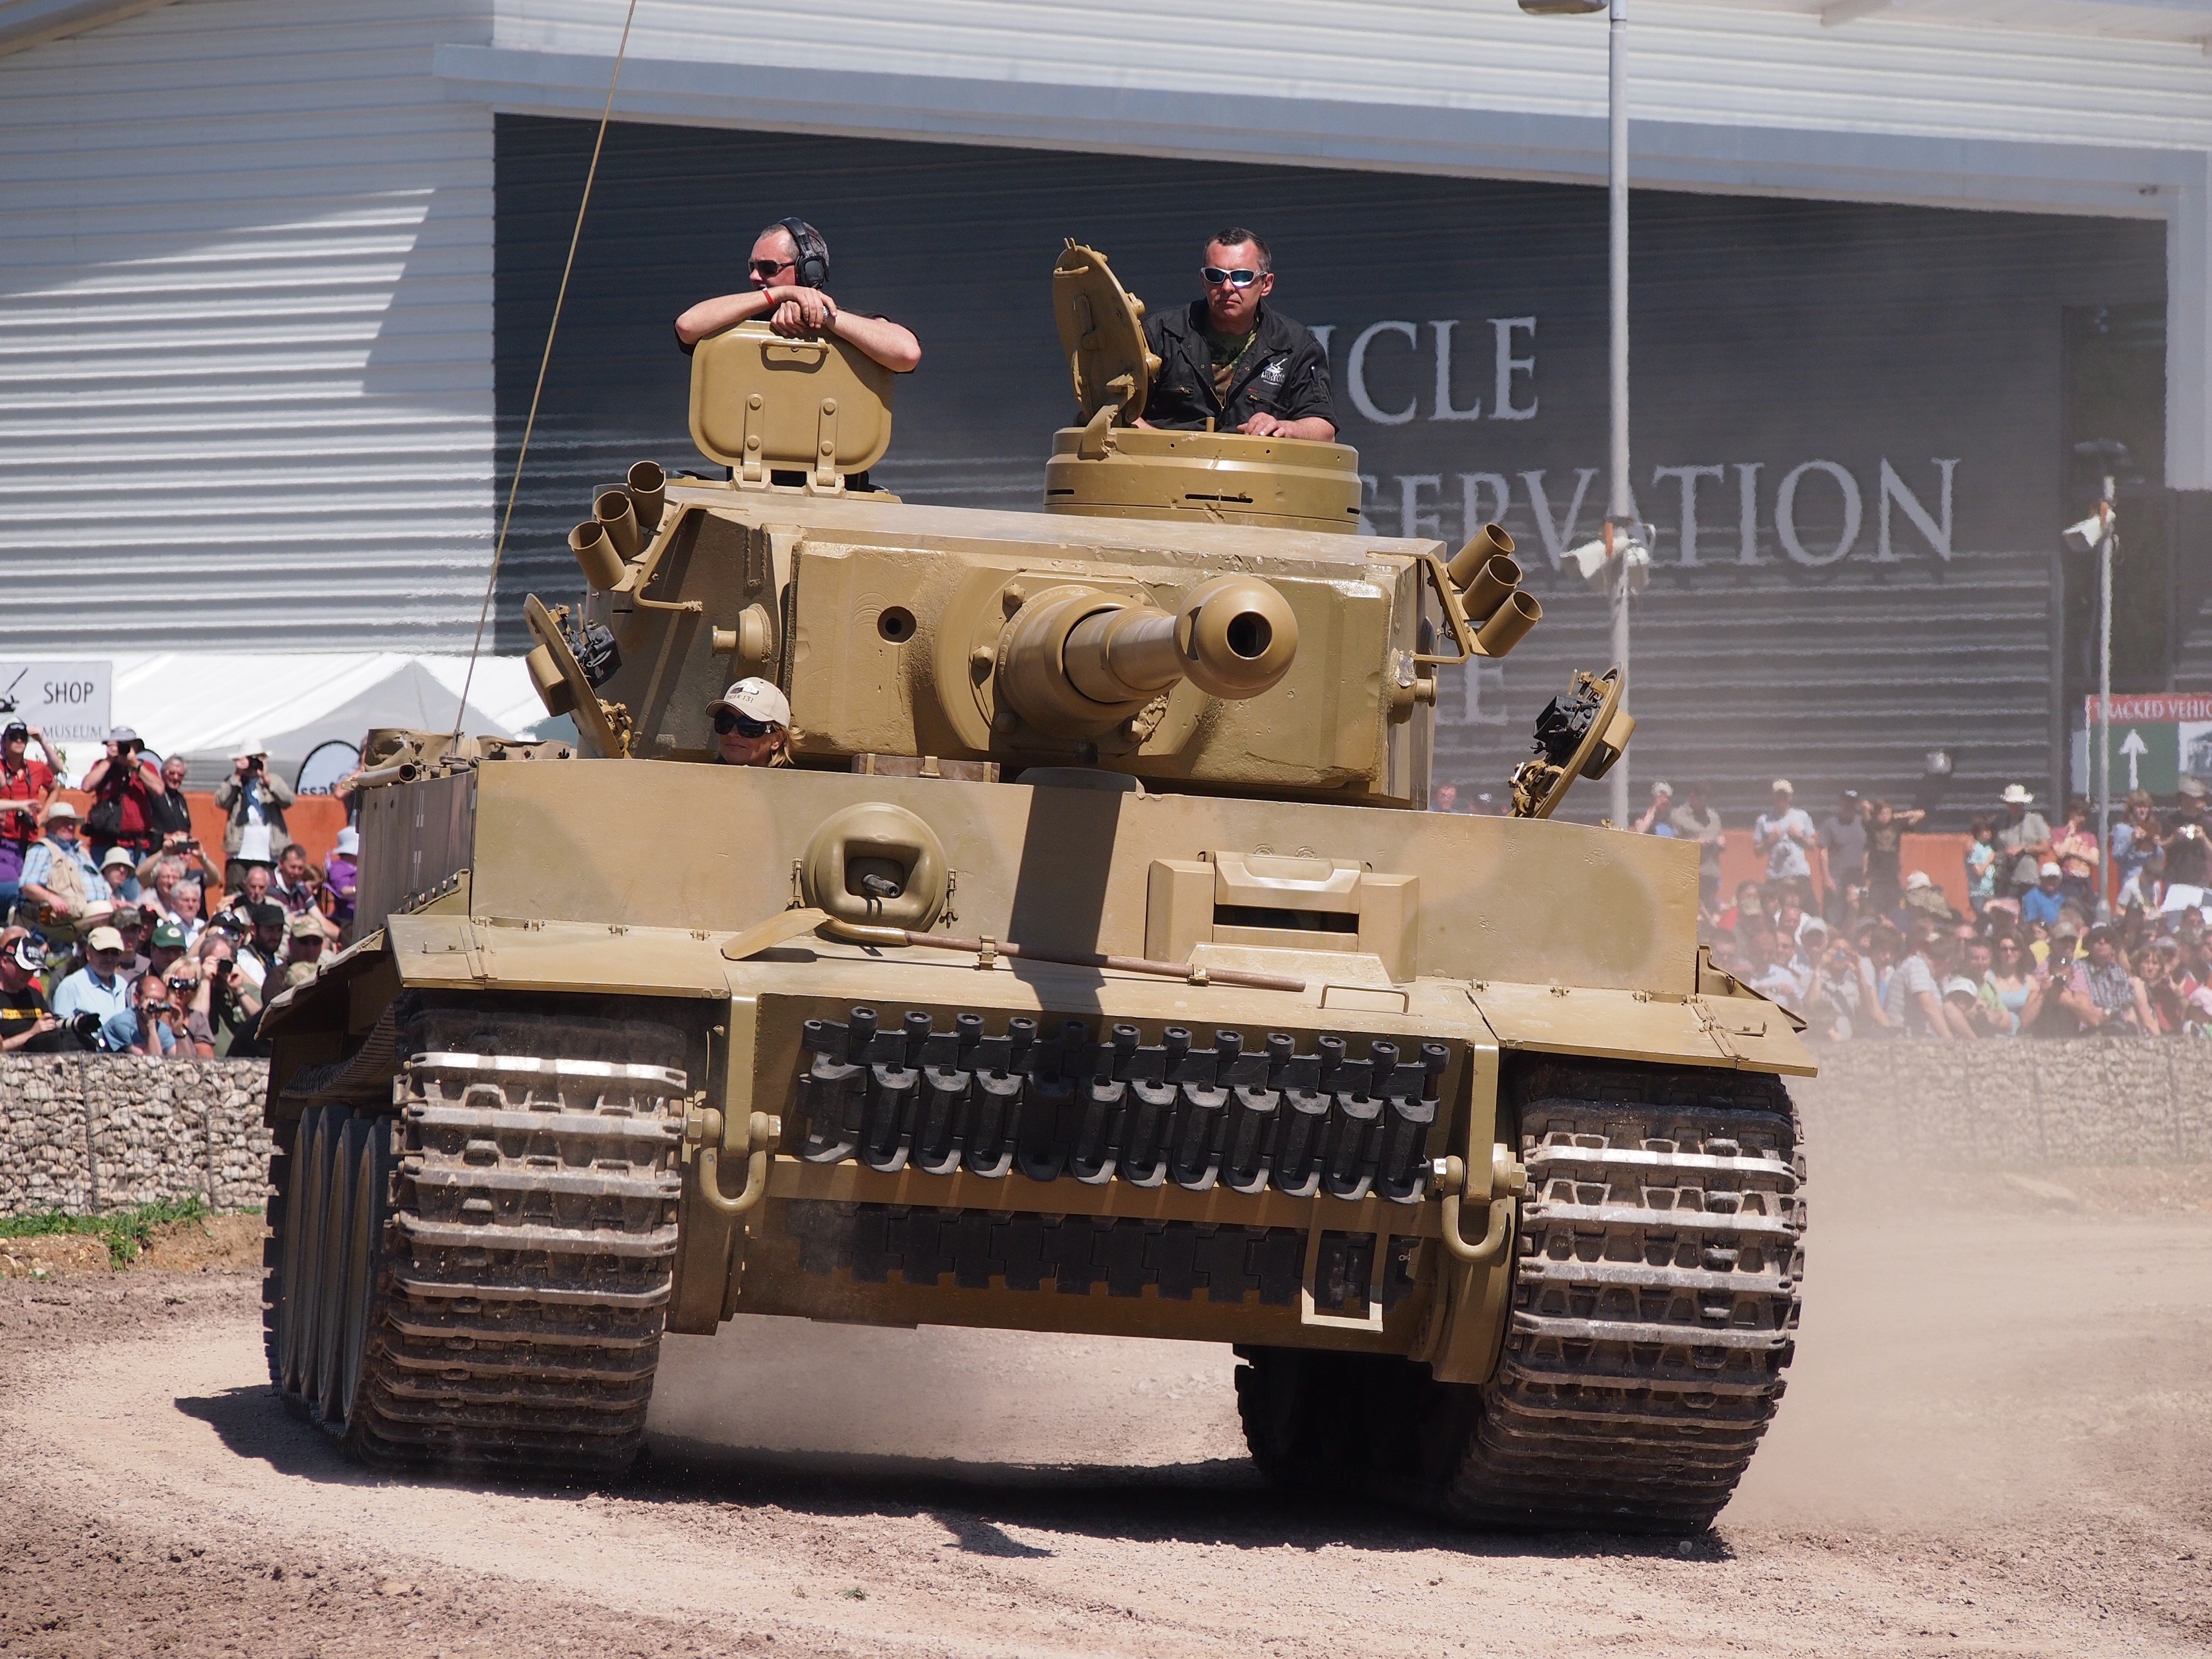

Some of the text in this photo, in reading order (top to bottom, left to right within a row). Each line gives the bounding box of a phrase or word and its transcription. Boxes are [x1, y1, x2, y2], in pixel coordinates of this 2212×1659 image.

[1261, 371, 1285, 382] MUSEUM
[43, 681, 94, 704] SHOP
[742, 695, 754, 703] 131
[42, 725, 103, 738] MUSEUM
